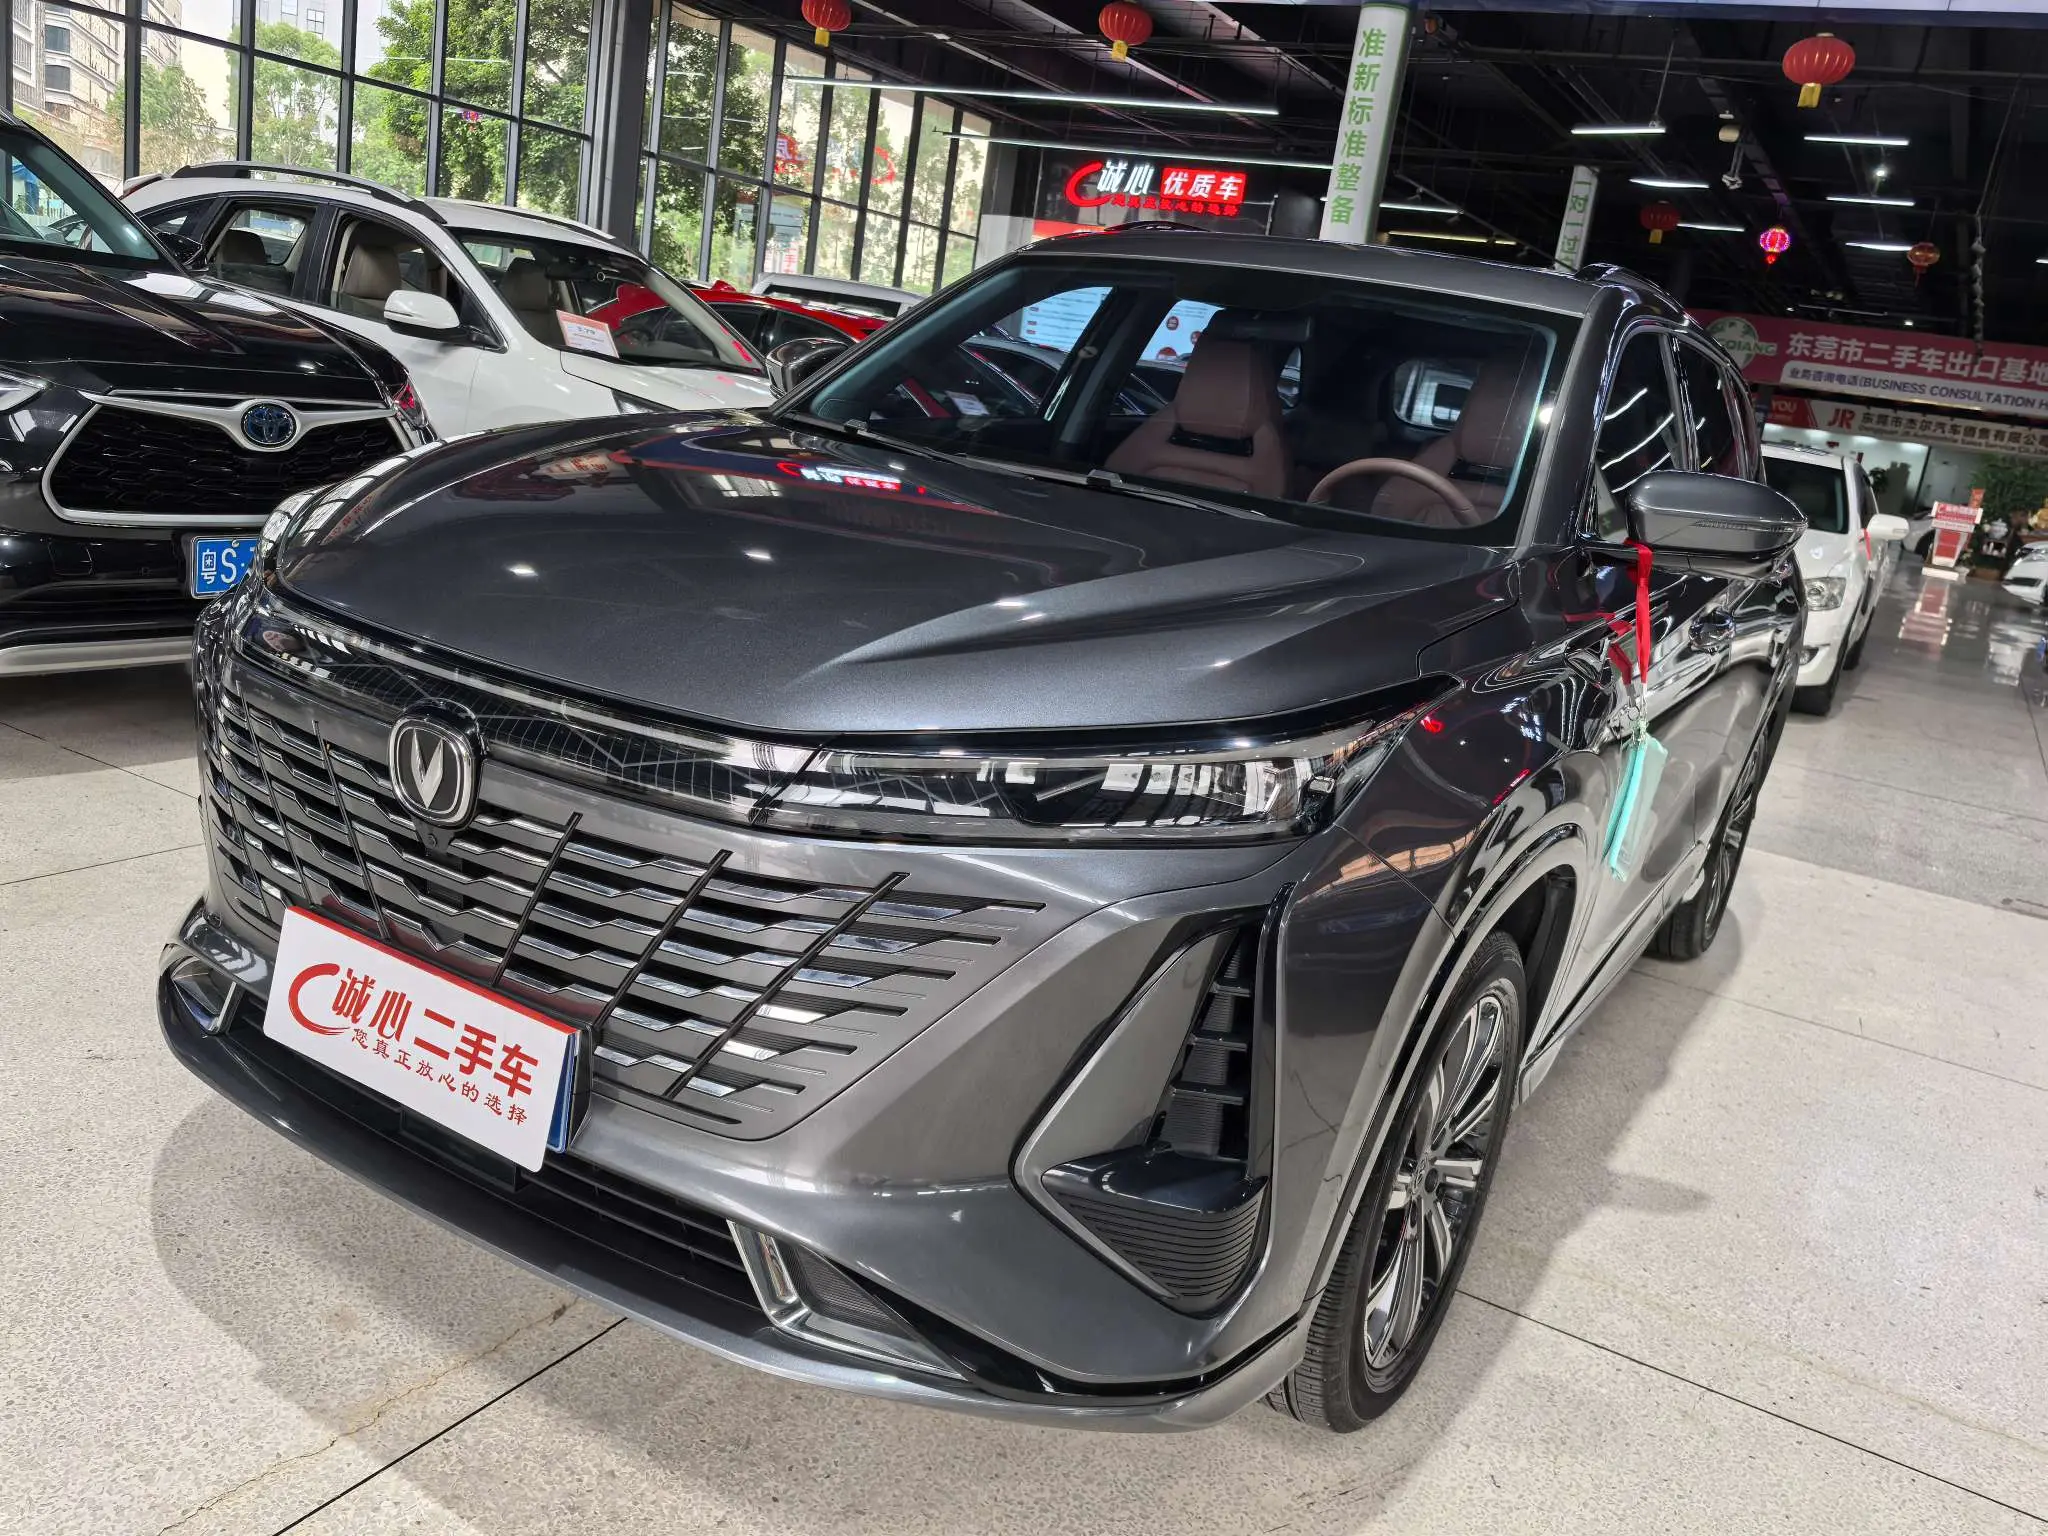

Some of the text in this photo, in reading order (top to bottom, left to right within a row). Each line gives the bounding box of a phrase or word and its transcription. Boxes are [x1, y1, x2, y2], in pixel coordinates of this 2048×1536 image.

[1330, 27, 1387, 225] 准新标准整备
[1096, 159, 1243, 201] 诚心 优质车
[1786, 331, 2048, 387] 东莞市二手车出口基地
[1828, 407, 1856, 429] JR
[1930, 385, 2036, 408] CONSULTATION
[200, 547, 257, 585] 粤S·
[331, 967, 539, 1099] 诚心二手车
[351, 1027, 528, 1126] 您真正放心的选择
